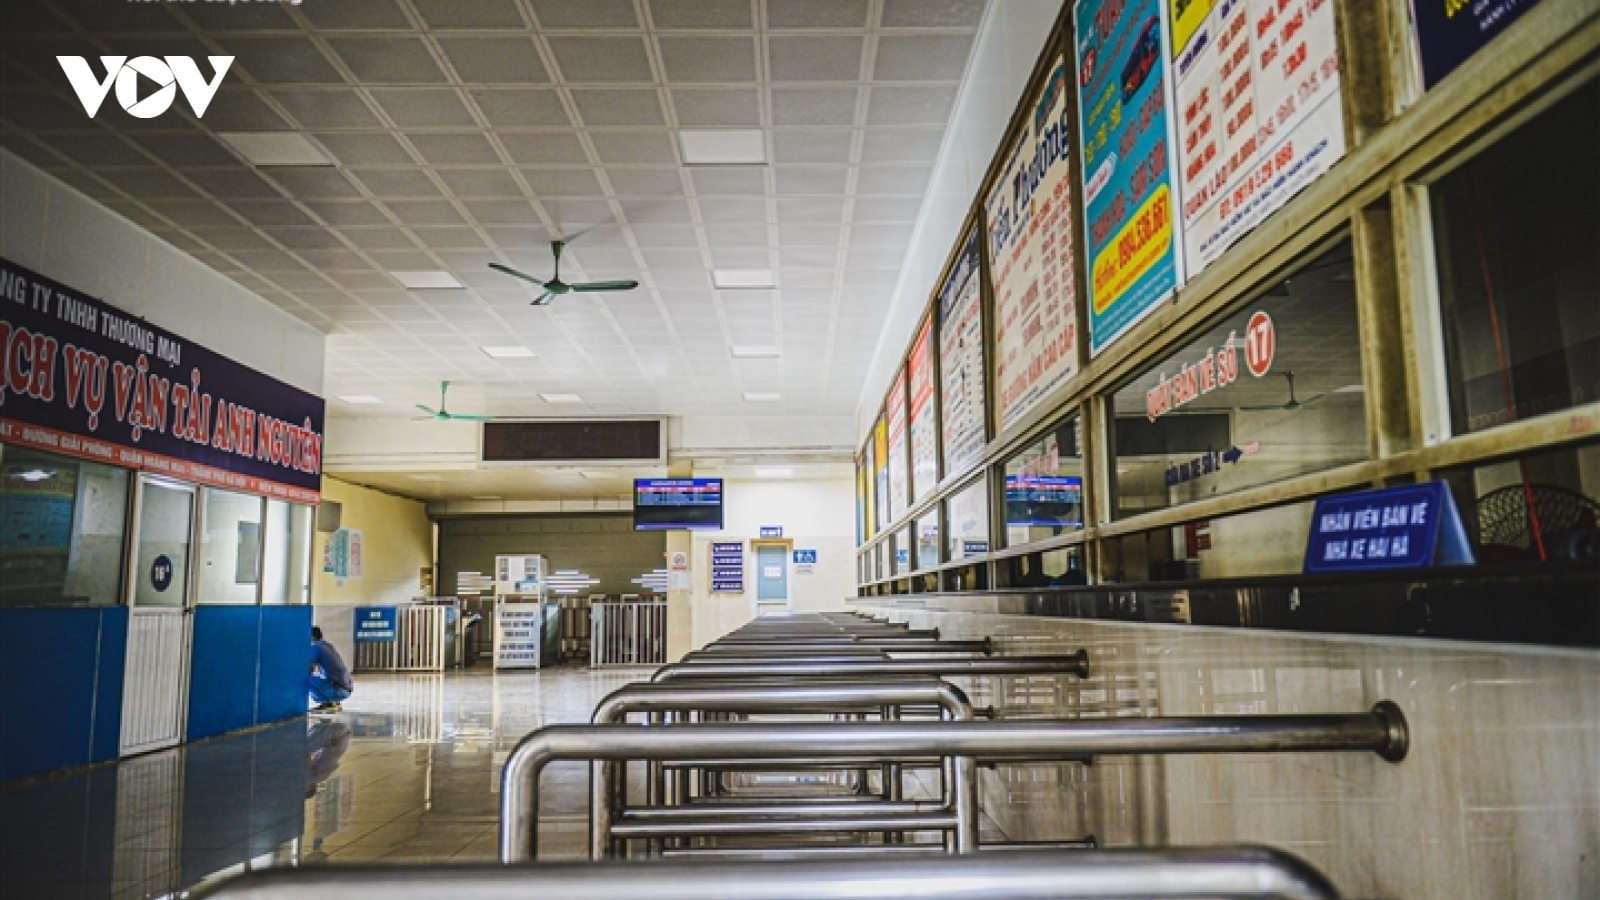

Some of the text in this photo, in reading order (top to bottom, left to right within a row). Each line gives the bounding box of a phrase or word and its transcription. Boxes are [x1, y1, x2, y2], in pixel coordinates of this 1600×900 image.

[31, 282, 52, 314] TY
[56, 294, 98, 332] TNHH
[102, 312, 155, 354] THƯƠNG
[157, 335, 181, 367] MẠI
[1173, 363, 1198, 408] BÁN
[1198, 347, 1216, 394] VÉ
[1217, 329, 1237, 388] SỐ
[1248, 321, 1268, 366] 17
[63, 343, 109, 432] VỤ
[113, 354, 169, 442] VẬN
[172, 367, 211, 445] TẢI
[211, 398, 256, 458] ANH
[1320, 496, 1428, 533] NHÂN VIÊN BÁN VÉ
[1349, 538, 1367, 559] XE
